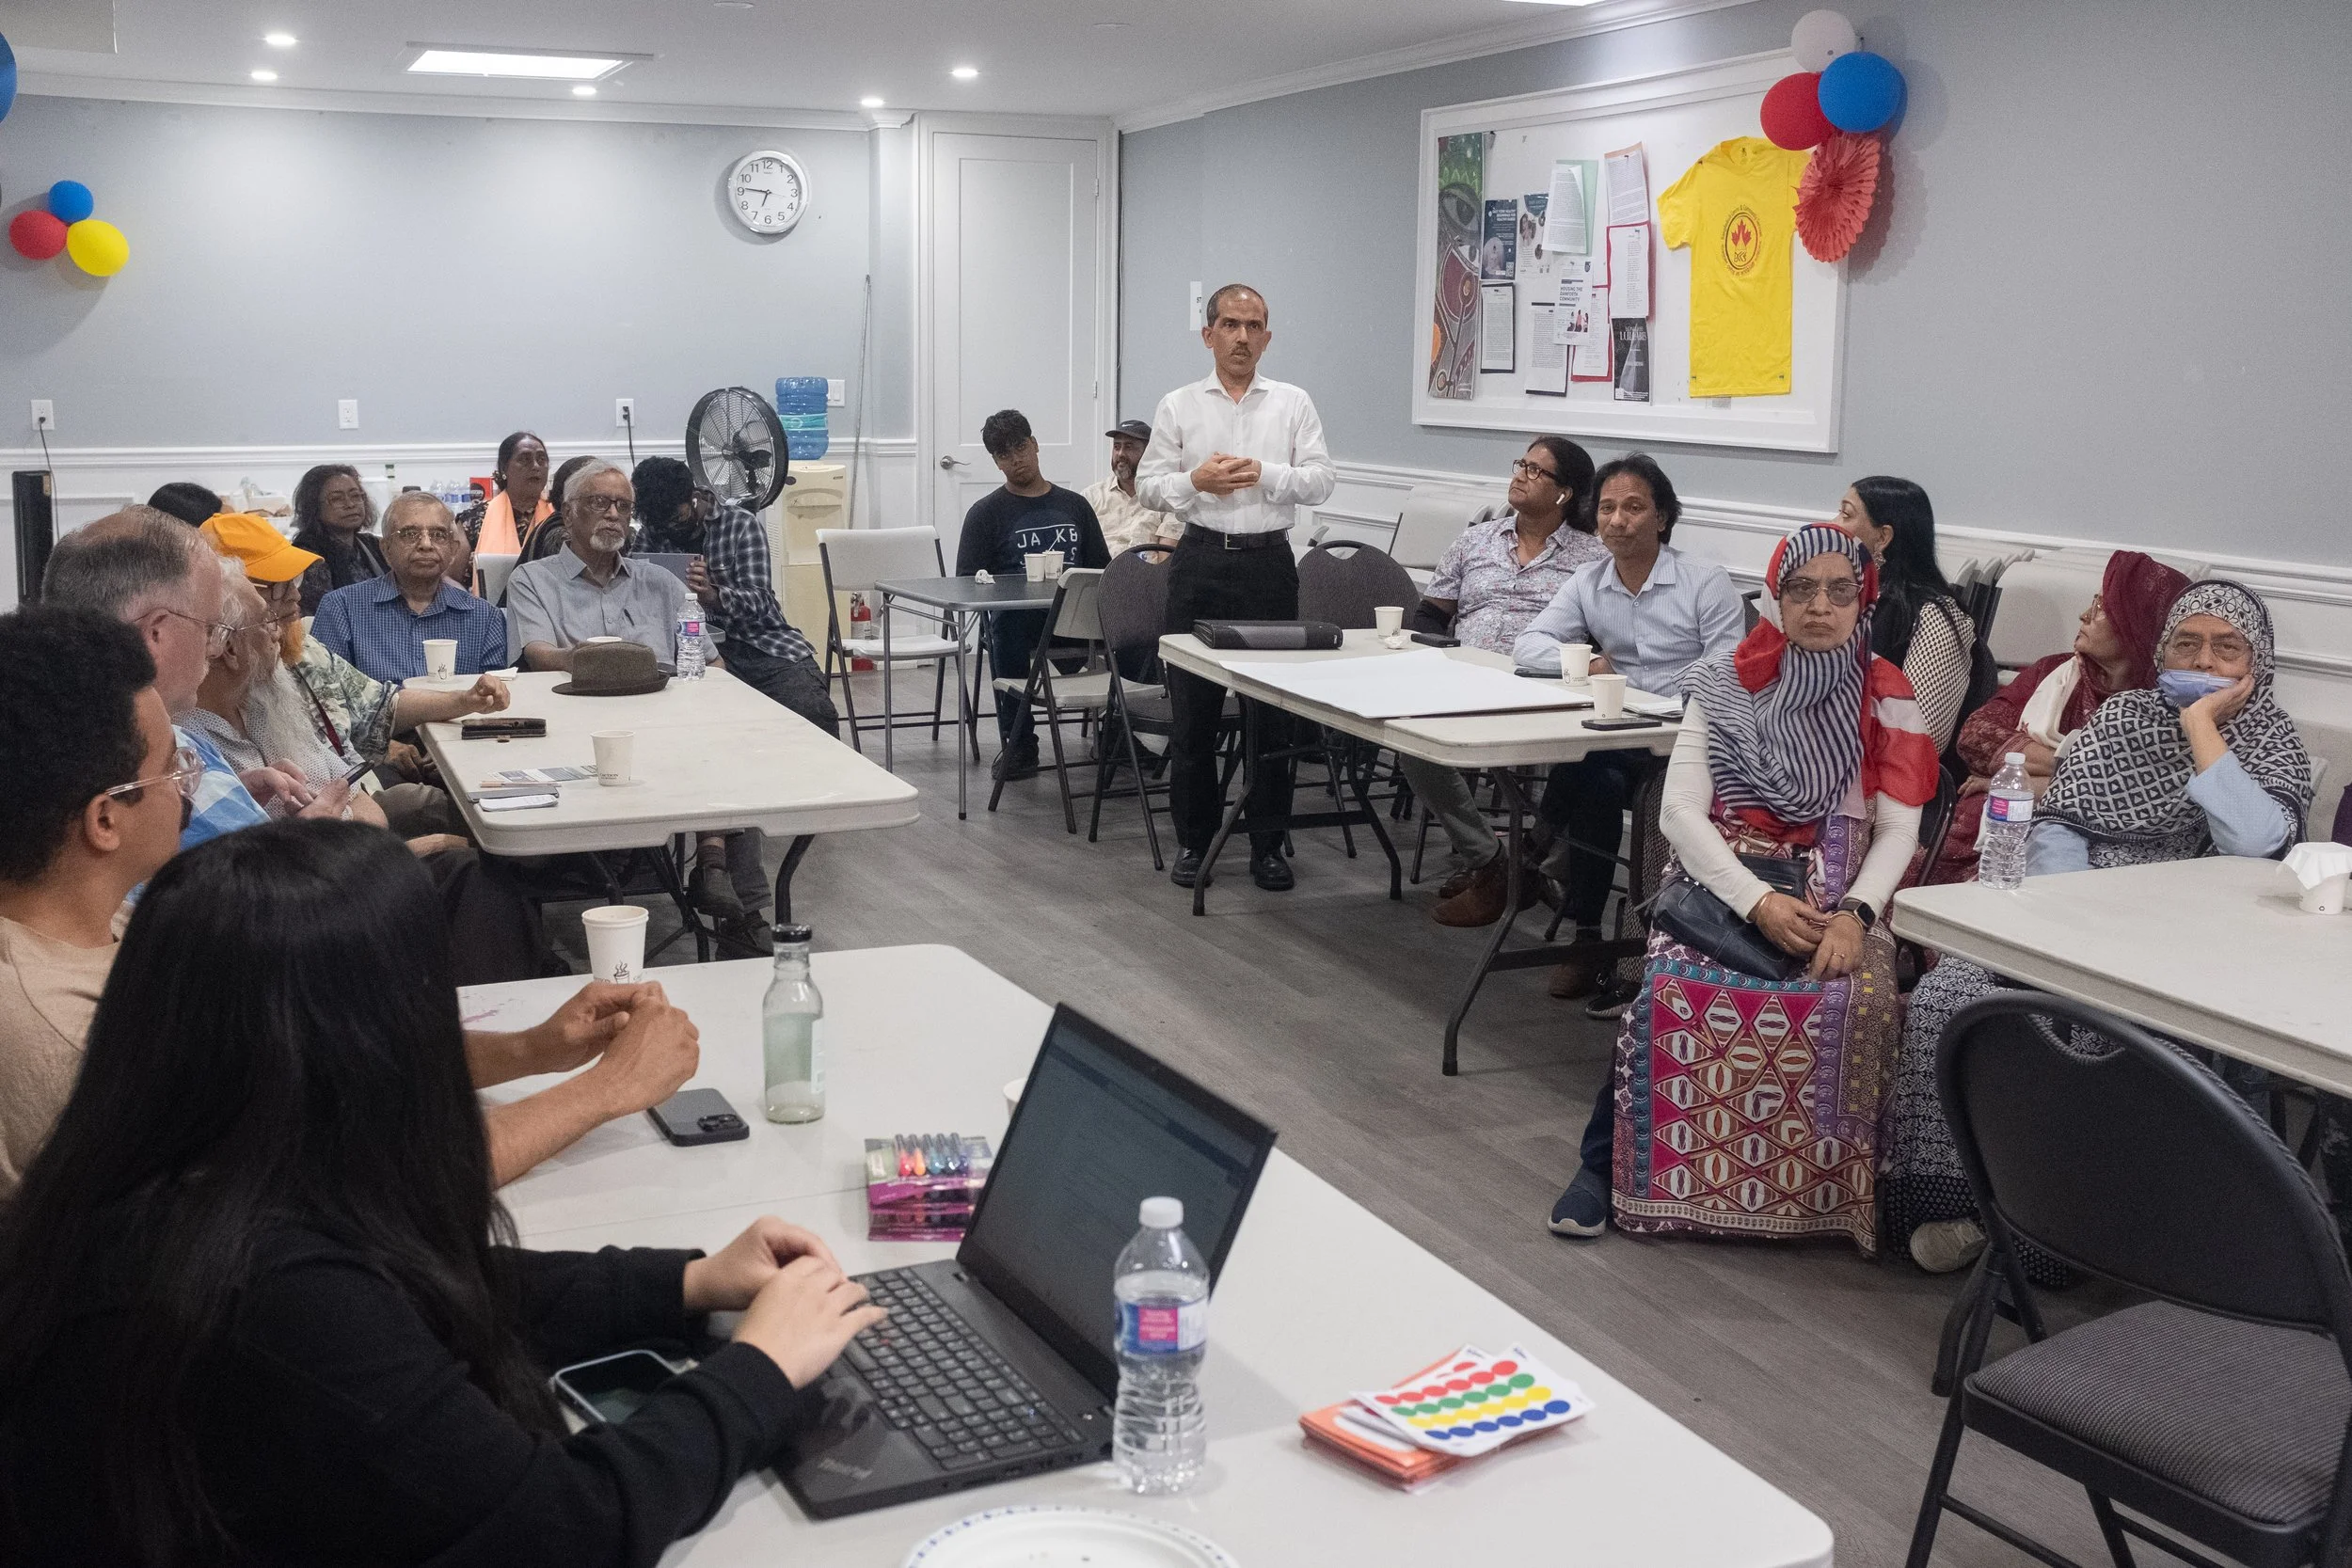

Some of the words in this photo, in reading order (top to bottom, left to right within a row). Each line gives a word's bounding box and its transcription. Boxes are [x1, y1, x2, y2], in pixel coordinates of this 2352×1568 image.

[750, 163, 759, 173] 11
[762, 159, 773, 170] 12
[740, 173, 752, 183] 10
[787, 174, 794, 184] 2
[737, 186, 745, 197] 9
[790, 188, 798, 198] 3
[740, 200, 749, 210] 8
[787, 202, 794, 211] 4
[751, 211, 758, 220] 7
[764, 215, 772, 225] 6
[777, 211, 786, 221] 5
